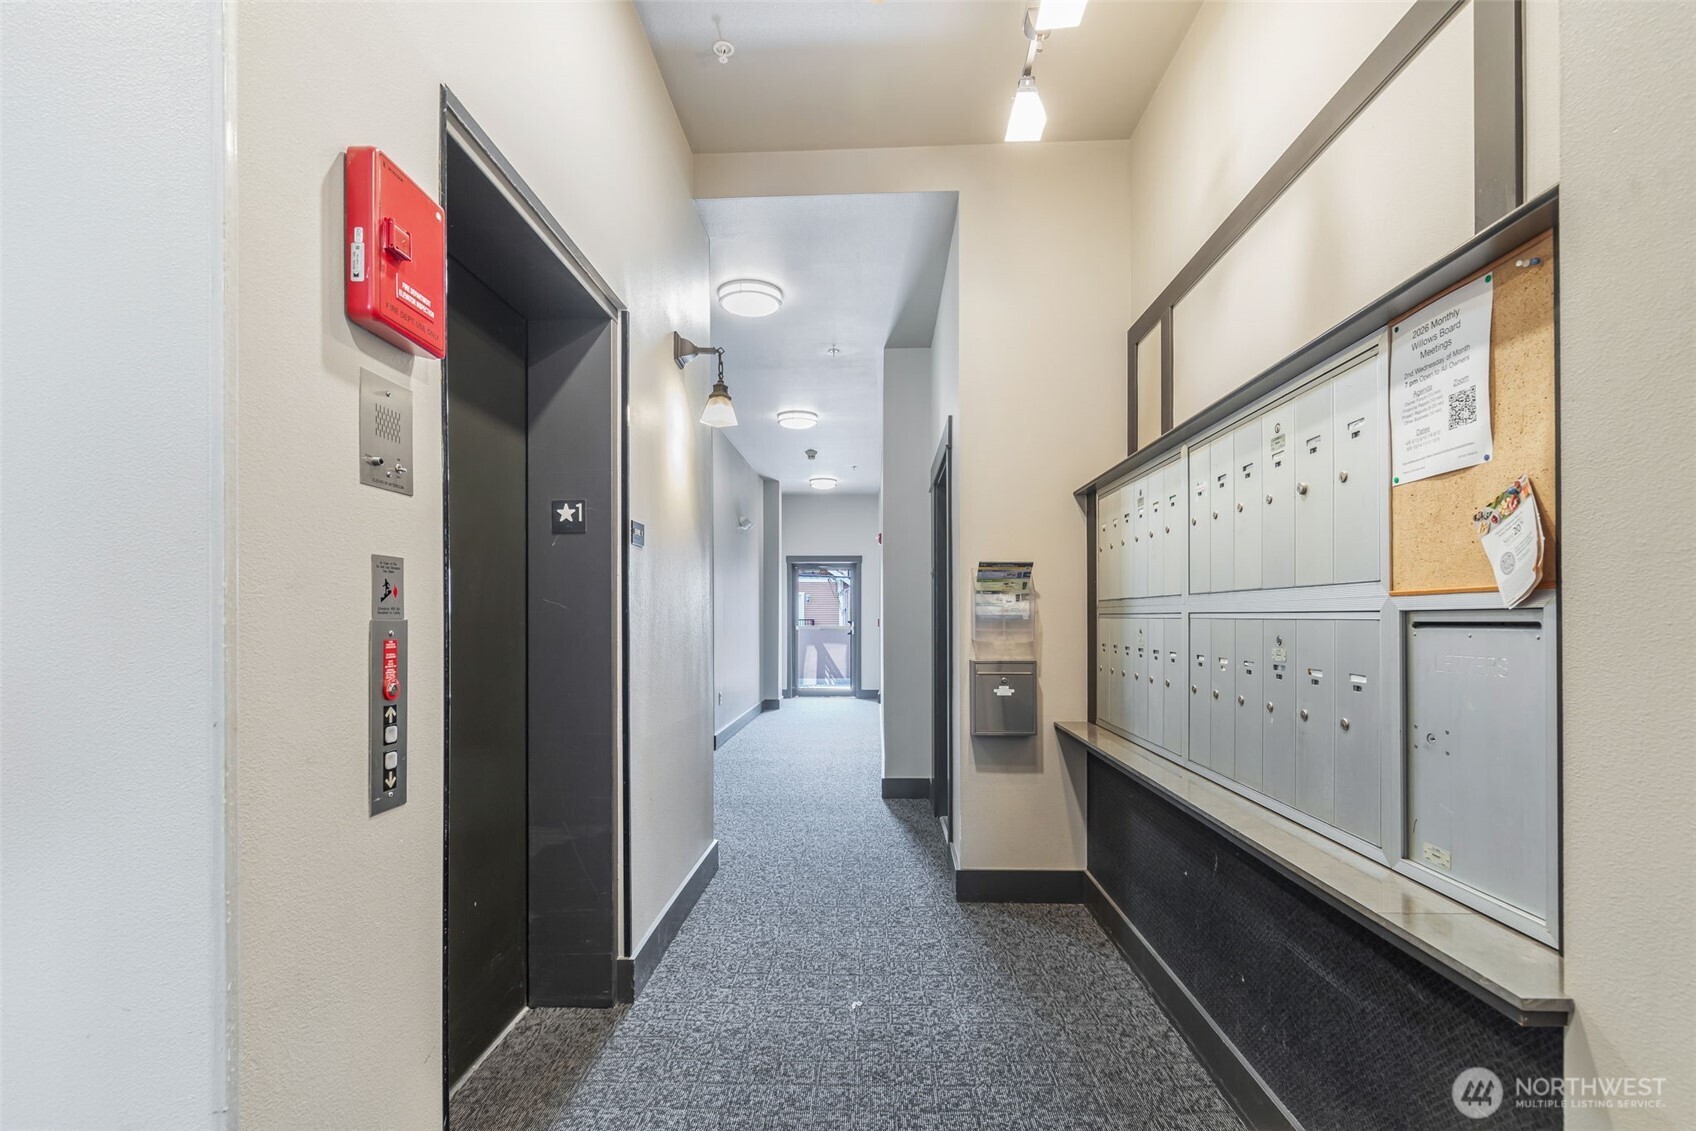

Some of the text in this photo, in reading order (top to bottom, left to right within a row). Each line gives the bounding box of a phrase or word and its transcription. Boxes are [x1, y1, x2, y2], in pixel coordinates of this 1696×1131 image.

[386, 301, 398, 315] FIRE
[416, 322, 425, 332] USE
[1412, 309, 1460, 339] 2026 Monthly
[1411, 319, 1461, 351] Willows Board
[1420, 339, 1452, 359] Meetings
[1404, 344, 1471, 380] 2nd Wednesday of Month
[1409, 379, 1418, 388] pm
[1419, 371, 1433, 382] Open
[1449, 355, 1470, 369] Owners
[1453, 375, 1470, 387] Zoom
[576, 503, 582, 521] 1
